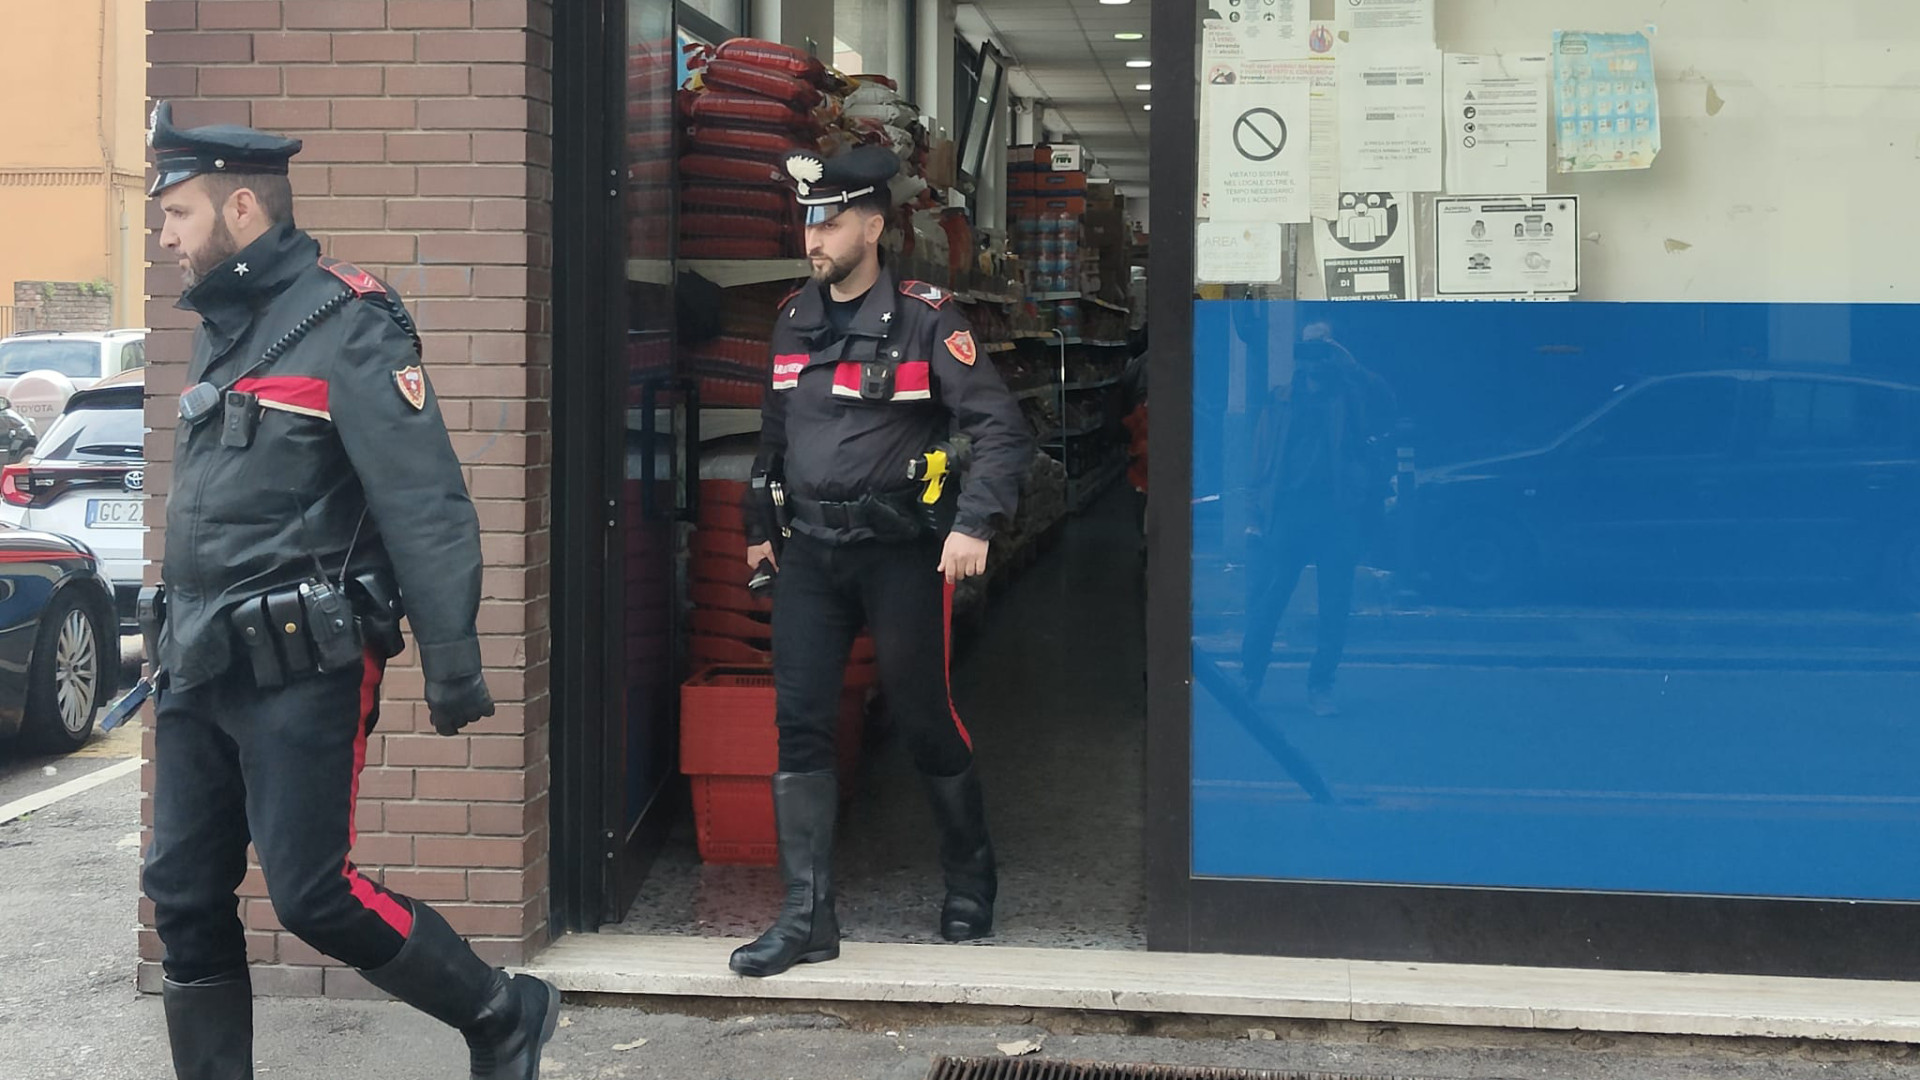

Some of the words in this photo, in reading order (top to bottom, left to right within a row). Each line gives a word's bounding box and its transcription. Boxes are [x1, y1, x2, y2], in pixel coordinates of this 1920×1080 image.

[1229, 170, 1258, 178] VIETATO
[1232, 196, 1247, 204] PER
[1203, 236, 1238, 248] AREA
[1340, 279, 1350, 287] DI
[15, 404, 54, 413] TOYOTA
[99, 503, 122, 521] GC
